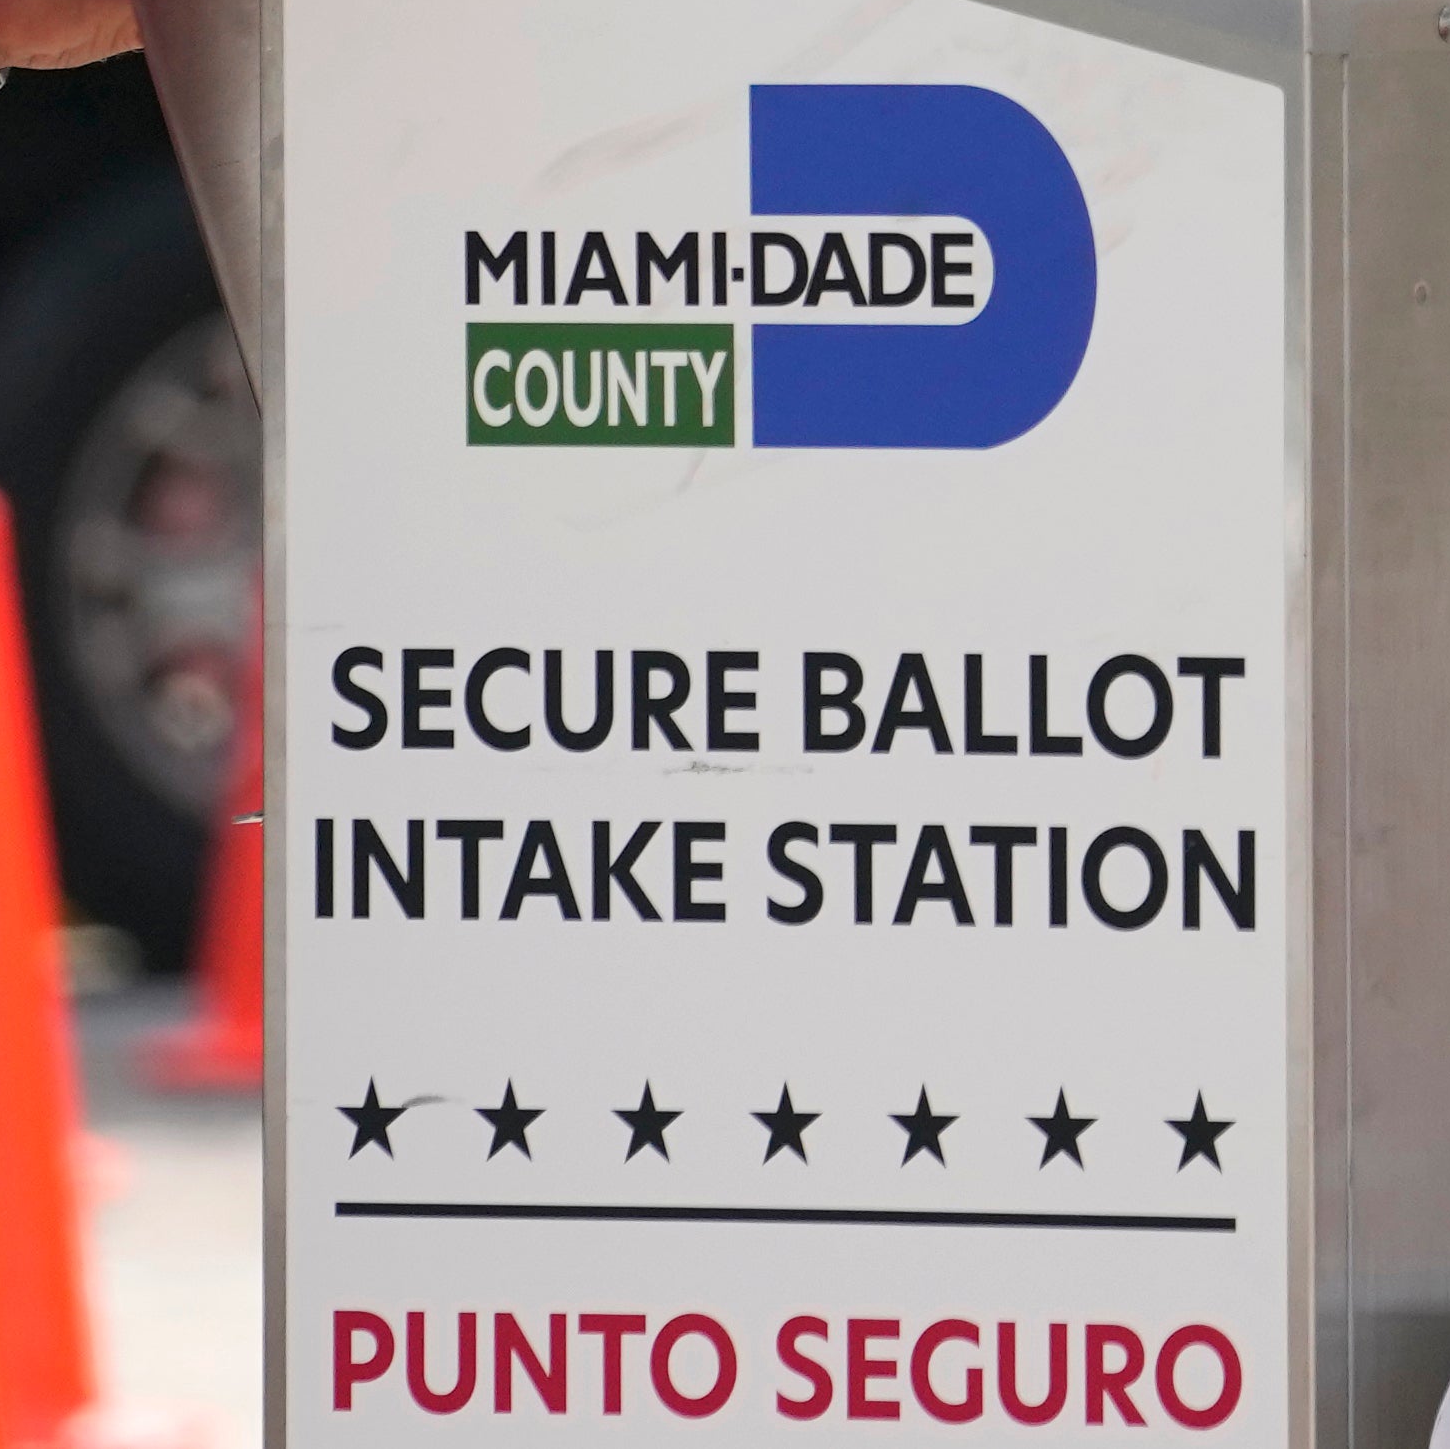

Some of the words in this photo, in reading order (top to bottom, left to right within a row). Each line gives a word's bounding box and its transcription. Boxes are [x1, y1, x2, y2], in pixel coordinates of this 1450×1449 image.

[474, 350, 726, 426] COUNTY
[333, 647, 759, 752] SECURE
[804, 652, 1244, 758] BALLOT
[316, 819, 725, 922] INTAKE
[768, 821, 1255, 929] STATION
[334, 1311, 737, 1418] PUNTO
[777, 1315, 1242, 1429] SEGURO
